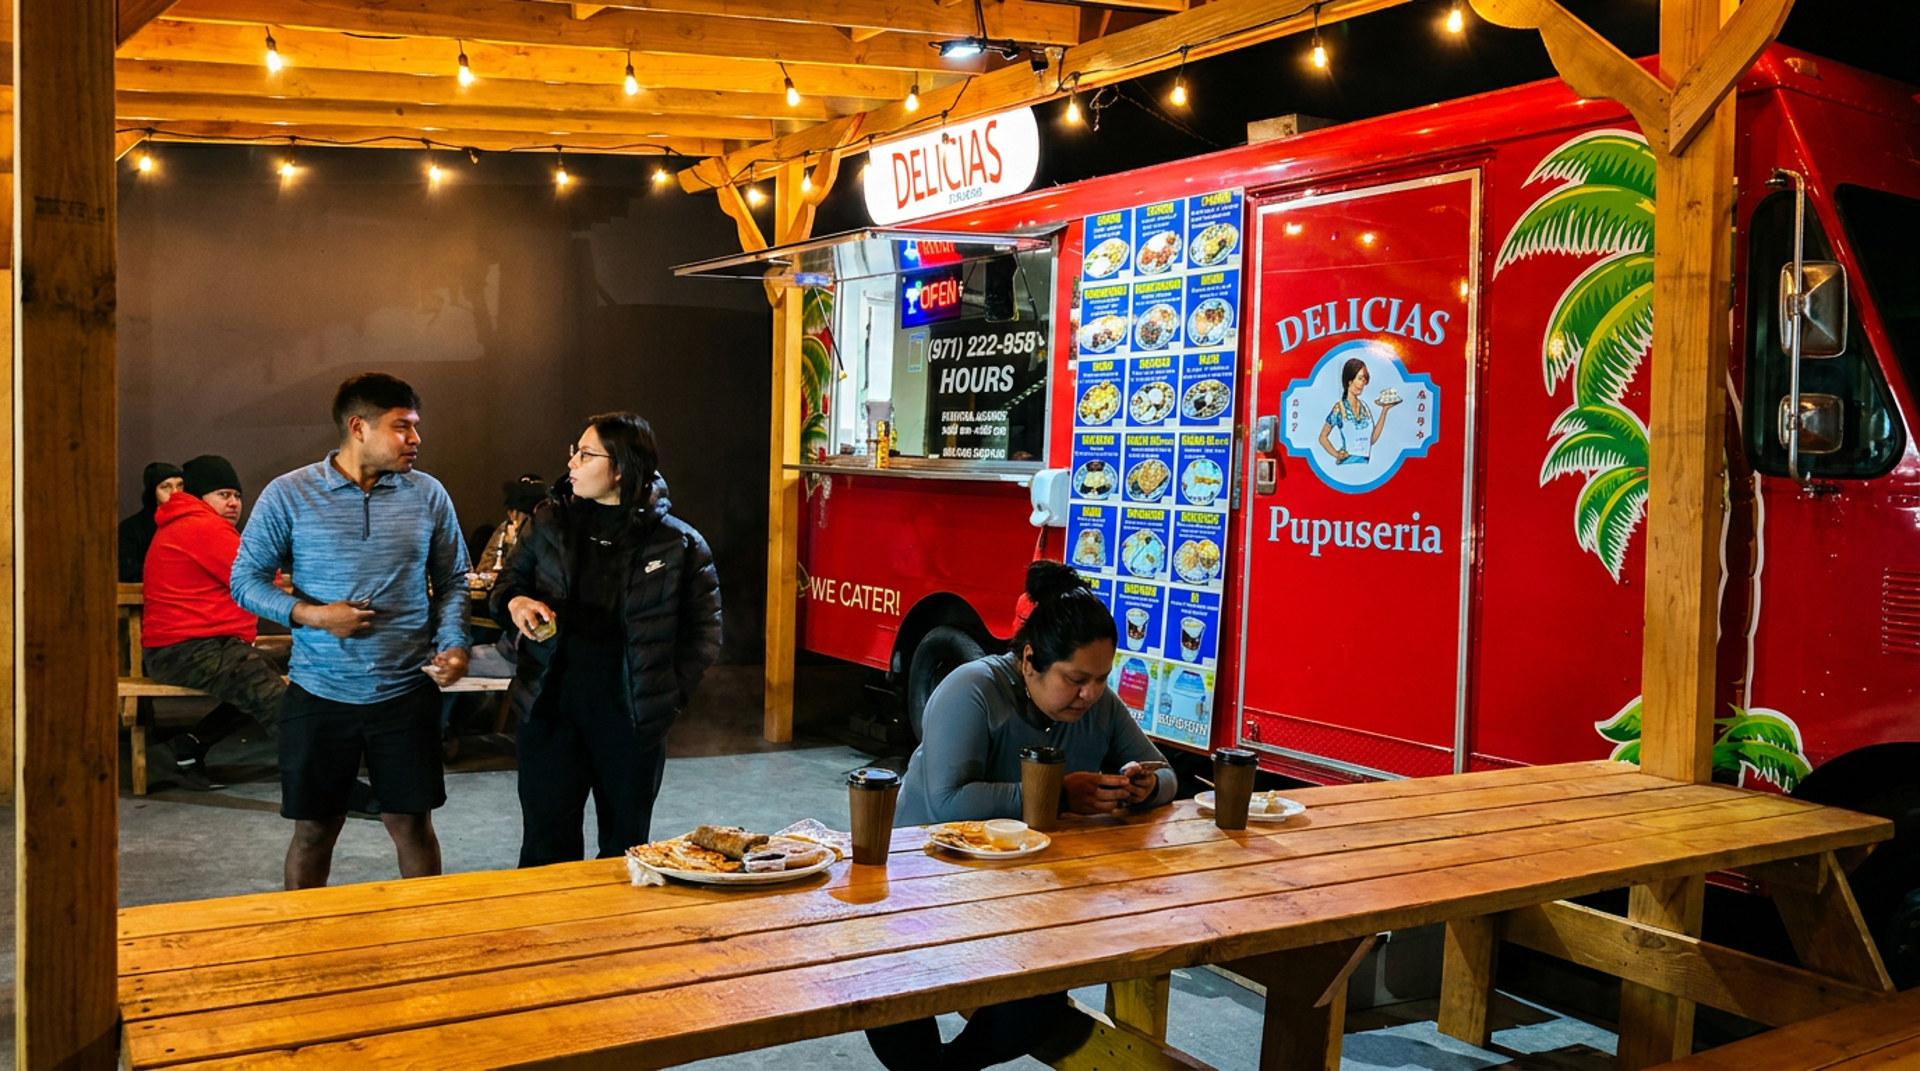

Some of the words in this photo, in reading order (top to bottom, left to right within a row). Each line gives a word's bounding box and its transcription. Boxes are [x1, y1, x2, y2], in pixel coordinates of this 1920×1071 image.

[892, 119, 1003, 210] DELICIAS
[927, 337, 963, 363] (971)
[966, 330, 1045, 357] 222-958
[1275, 296, 1450, 354] DELICIAS
[939, 364, 1015, 394] HOURS
[1267, 505, 1443, 557] Pupuseria
[810, 576, 836, 604] WE
[840, 581, 901, 617] CATER!
